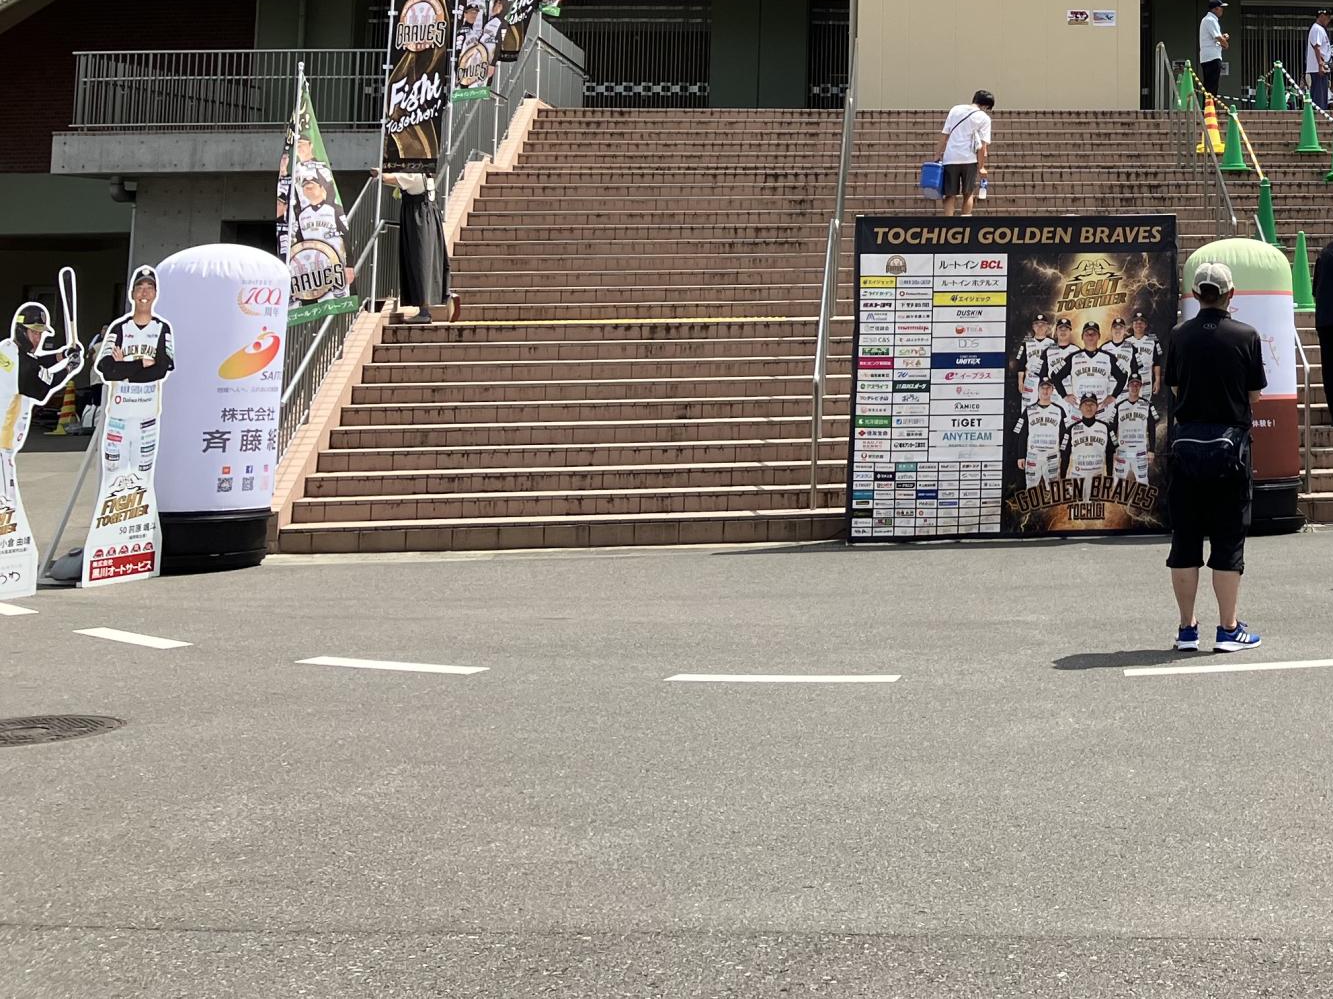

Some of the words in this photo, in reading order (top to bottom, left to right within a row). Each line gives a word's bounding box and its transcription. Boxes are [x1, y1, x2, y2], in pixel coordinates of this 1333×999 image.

[396, 21, 447, 50] BRAVES
[389, 72, 442, 116] Fight
[873, 227, 970, 244] TOCHIGI
[977, 227, 1073, 244] GOLDEN
[1080, 226, 1162, 243] BRAVES
[939, 259, 979, 269] ルートイン
[980, 260, 1004, 269] BCL
[291, 263, 346, 295] RAVES
[1063, 277, 1122, 299] FIGHT
[1057, 293, 1127, 313] TOGETHER
[221, 407, 275, 422] 株式会社
[943, 432, 992, 440] ANYTEAM
[101, 490, 146, 515] FIGHT
[1015, 477, 1085, 513] GOLDEN
[1090, 475, 1158, 511] BRAVES
[1067, 502, 1105, 520] TOCHIGI
